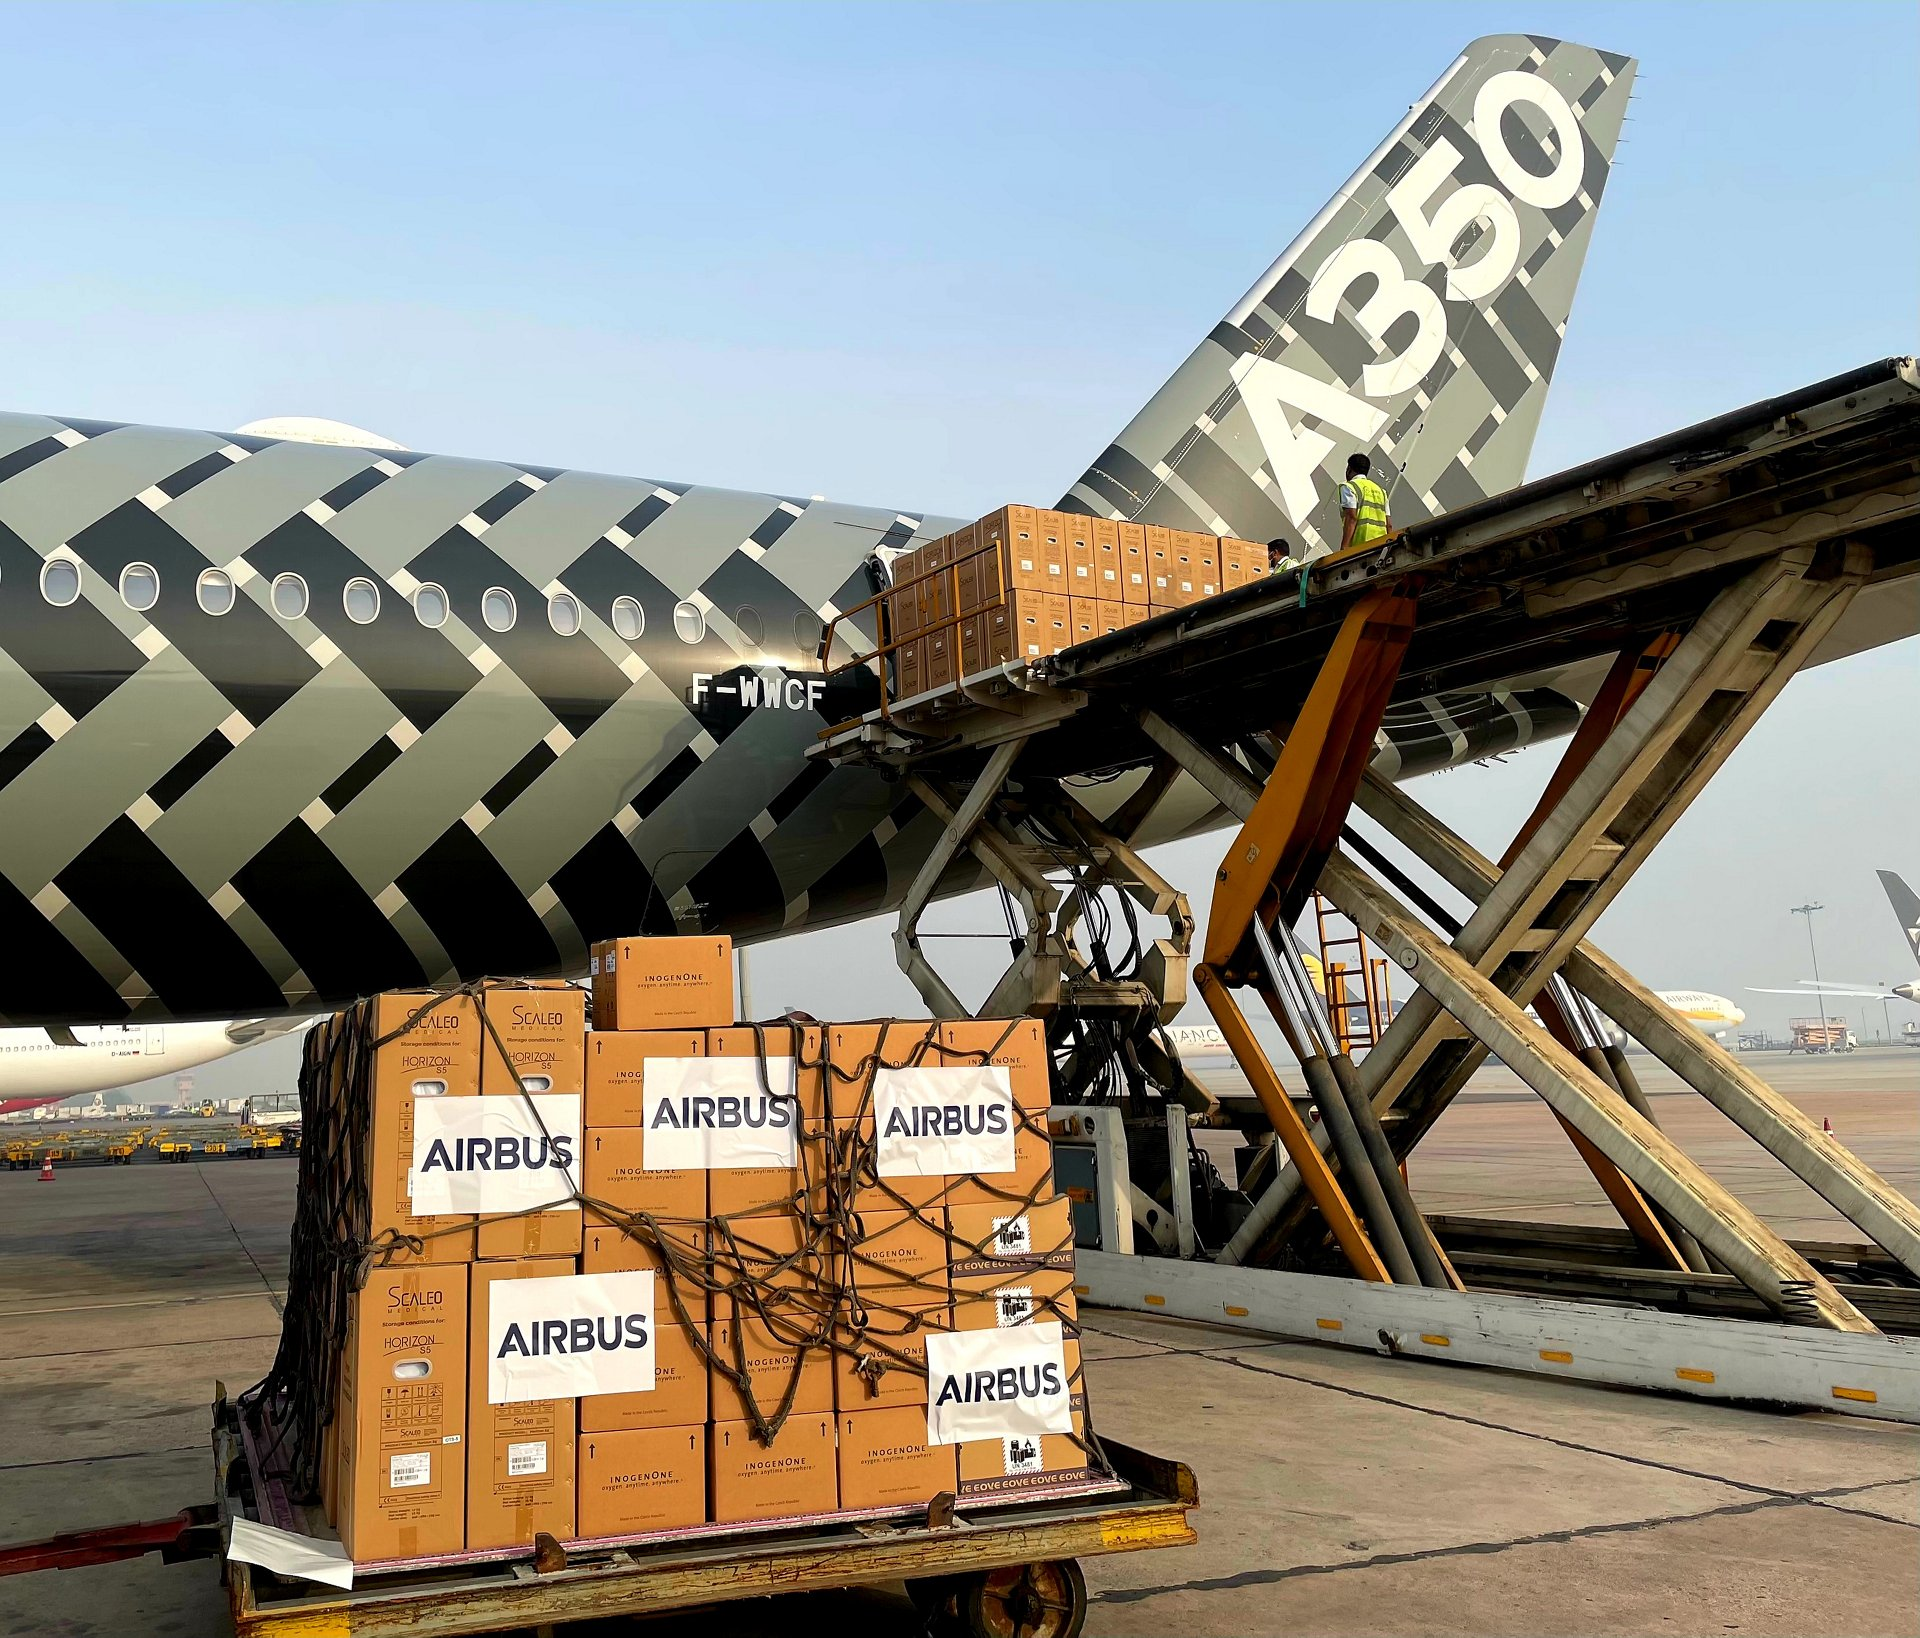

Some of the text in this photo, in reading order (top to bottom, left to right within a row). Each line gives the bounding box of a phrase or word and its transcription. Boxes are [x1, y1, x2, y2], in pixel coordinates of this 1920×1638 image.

[1228, 70, 1585, 530] A350
[692, 673, 826, 711] F-WWCF
[644, 973, 704, 982] INOGENONE
[1666, 994, 1710, 1003] AIRWAYS
[406, 1008, 459, 1029] SCALEO
[512, 1005, 562, 1025] SCALEO
[402, 1056, 451, 1067] HORIZON
[508, 1052, 556, 1062] HORIZON
[968, 1056, 1020, 1066] INOENONE
[542, 1062, 552, 1070] S5
[650, 1096, 790, 1129] AIRBUS
[884, 1104, 1008, 1138] AIRBUS
[420, 1136, 573, 1172] AIRBUS
[388, 1286, 442, 1308] SCALEO
[384, 1334, 435, 1348] HORIZON
[496, 1314, 648, 1358] AIRBUS
[420, 1346, 432, 1354] S5
[747, 1356, 796, 1366] NOGENON
[936, 1362, 1060, 1406] AIRBUS
[868, 1444, 926, 1457] INOGENONE
[745, 1458, 806, 1470] INOGENONE
[610, 1471, 674, 1484] INOGENONE
[974, 1480, 1000, 1490] EOVE
[1002, 1478, 1028, 1488] EOVE
[1031, 1474, 1057, 1485] EOVE
[1059, 1471, 1085, 1481] EOVE
